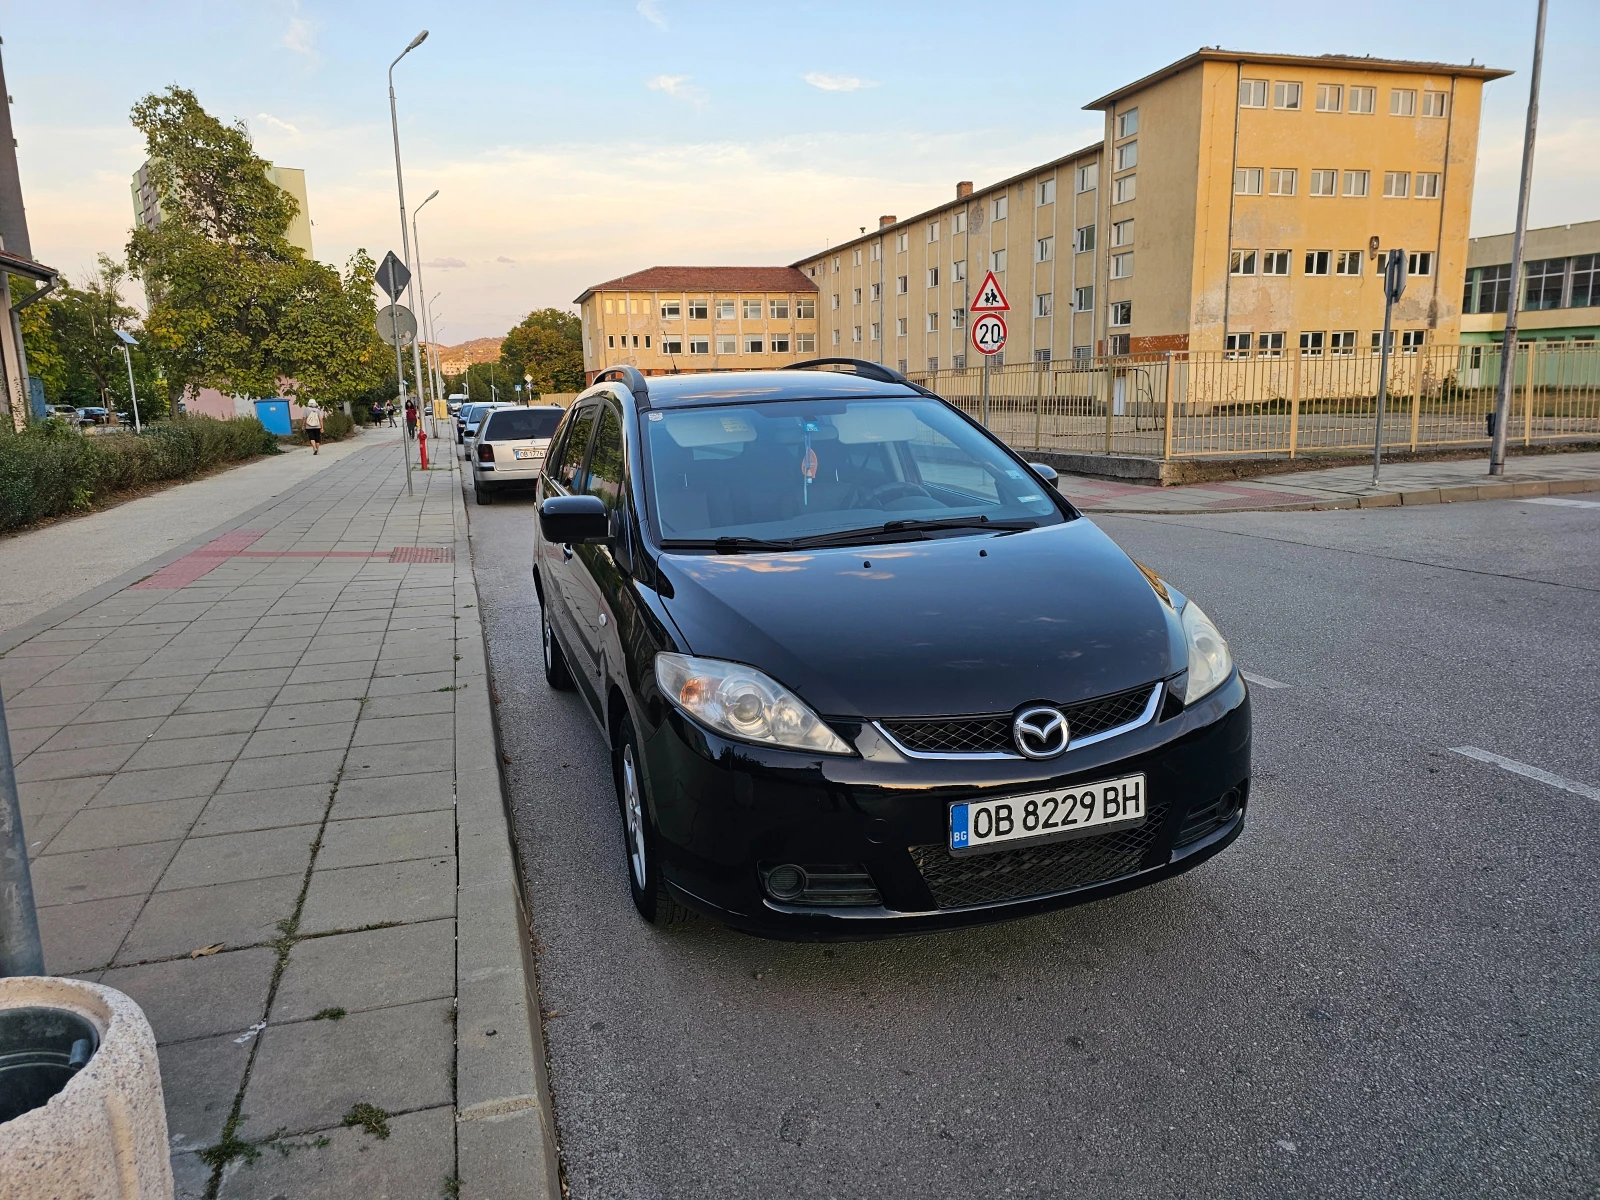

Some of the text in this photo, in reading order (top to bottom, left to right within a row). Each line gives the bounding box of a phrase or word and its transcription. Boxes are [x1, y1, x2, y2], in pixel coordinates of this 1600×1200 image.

[979, 323, 1001, 344] 20
[529, 449, 543, 457] 1776
[973, 782, 1140, 838] OB 8229 BH
[953, 831, 967, 842] BG
